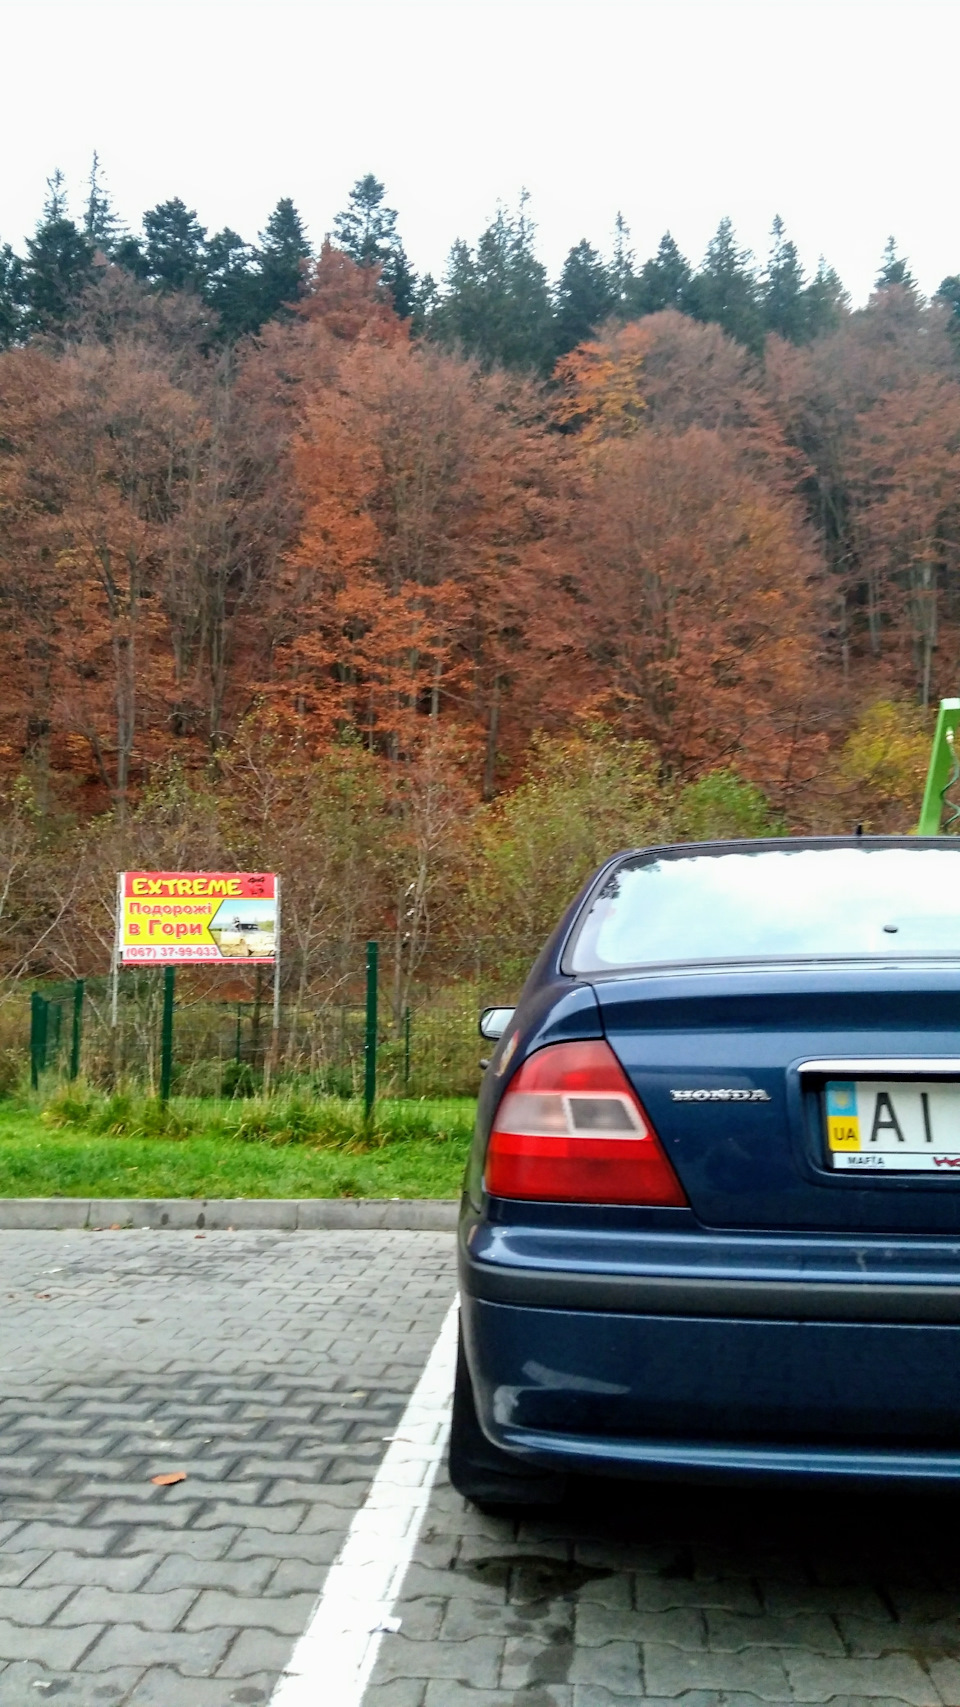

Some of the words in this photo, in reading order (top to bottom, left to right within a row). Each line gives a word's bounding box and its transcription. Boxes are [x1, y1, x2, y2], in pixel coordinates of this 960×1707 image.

[132, 878, 243, 895] EXTREME
[129, 902, 212, 917] Подорожі
[128, 924, 141, 935] в
[149, 919, 202, 938] Гори
[126, 947, 156, 958] (067)
[670, 1089, 772, 1101] HONDA
[870, 1092, 933, 1142] AI
[833, 1127, 858, 1141] UA
